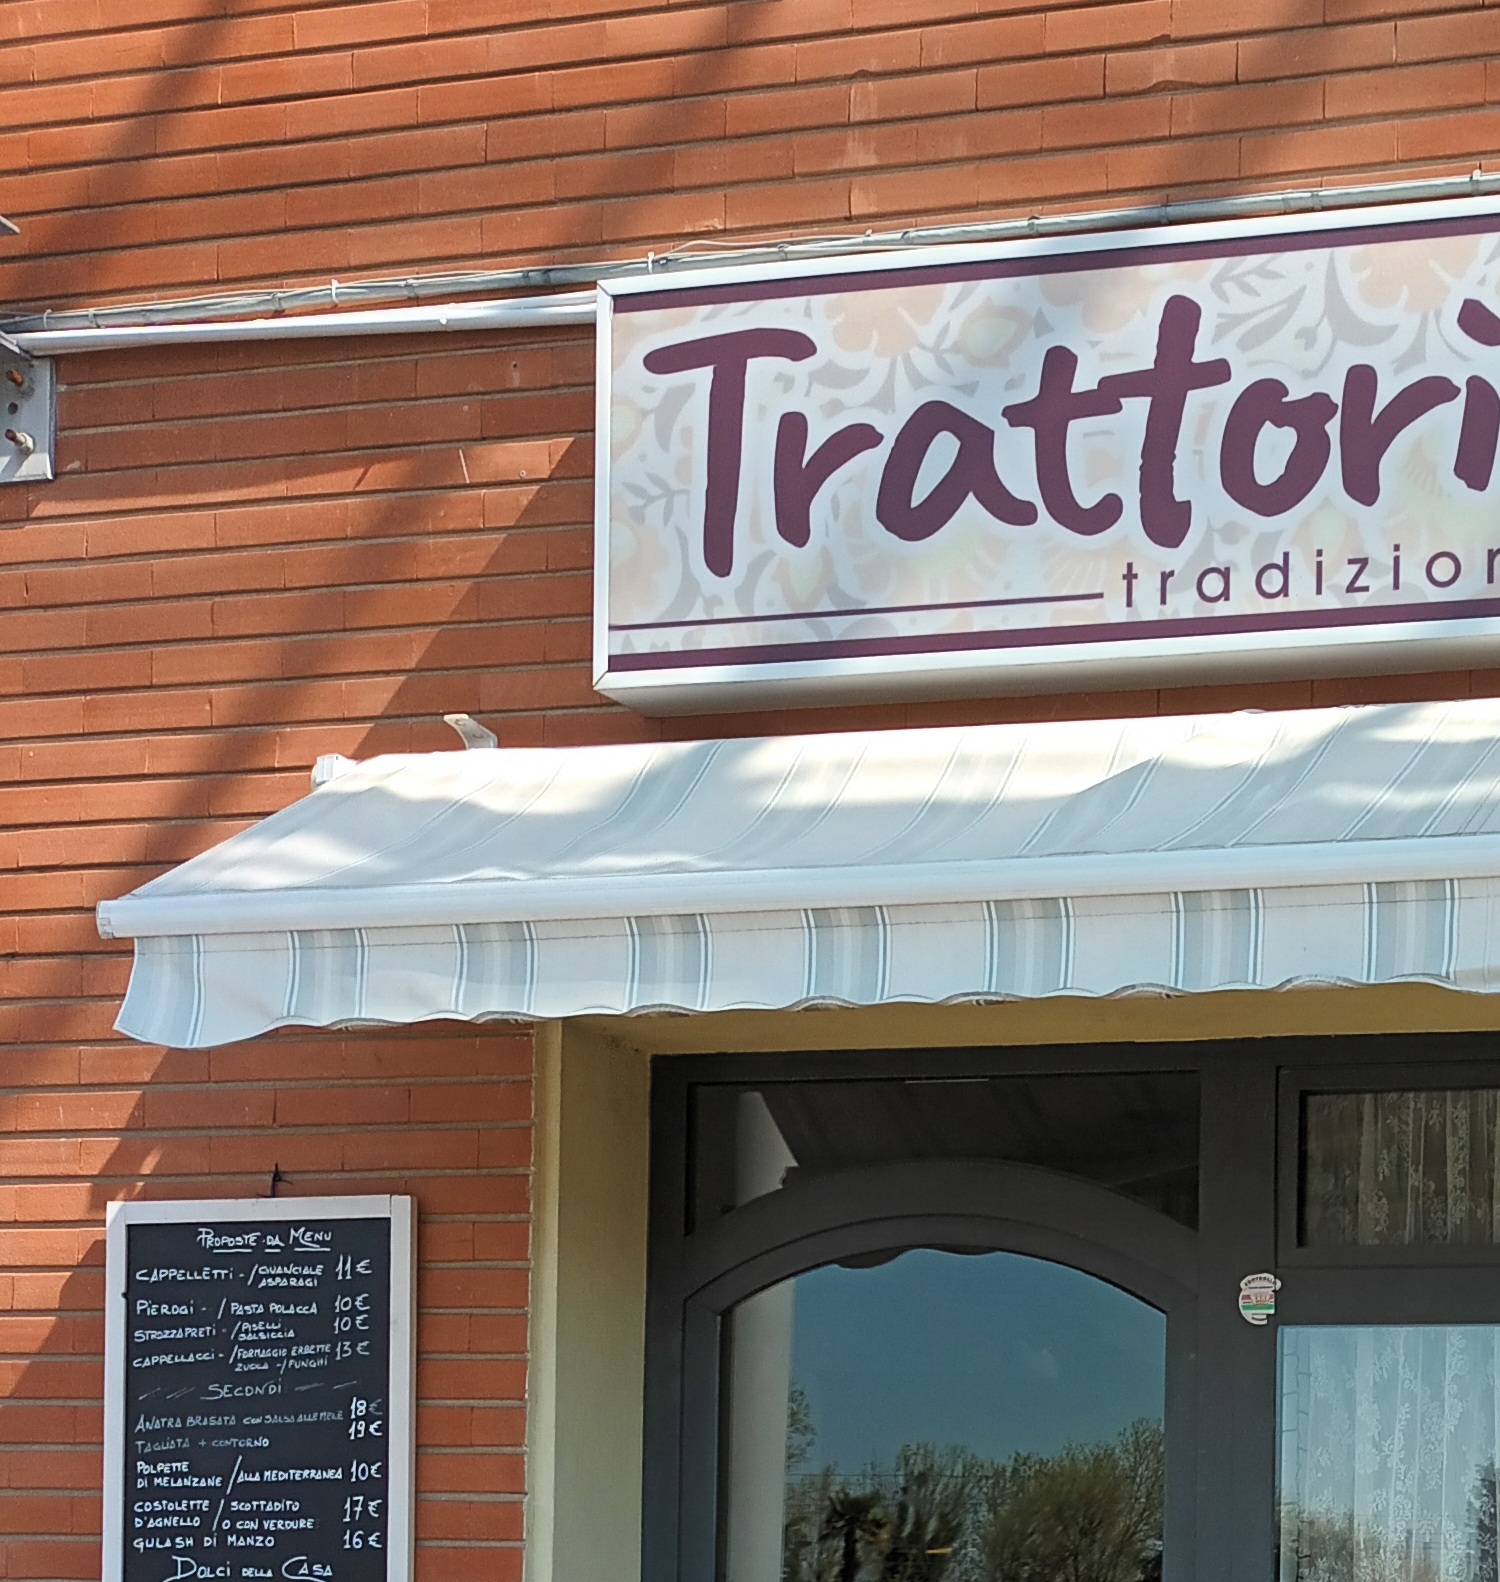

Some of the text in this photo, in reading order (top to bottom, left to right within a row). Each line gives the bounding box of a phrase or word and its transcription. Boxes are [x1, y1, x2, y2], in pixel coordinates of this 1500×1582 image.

[289, 1226, 332, 1248] MENU
[230, 1302, 265, 1315] PASTA
[269, 1302, 317, 1315] POLACCA
[291, 1343, 331, 1356] ERBETTE
[134, 1413, 182, 1433] ANATRA
[186, 1415, 236, 1427] BRASATA
[211, 1436, 269, 1448] CONTORNO
[136, 1461, 190, 1474] POLPETTE
[153, 1475, 223, 1488] MELANZANE
[134, 1500, 210, 1512] COSTOLETTE
[221, 1519, 231, 1530] O
[236, 1518, 259, 1530] CON
[263, 1518, 315, 1530] VERDURE
[133, 1536, 194, 1553] GULASH
[227, 1534, 275, 1547] MANZO
[242, 1567, 273, 1577] DELLA
